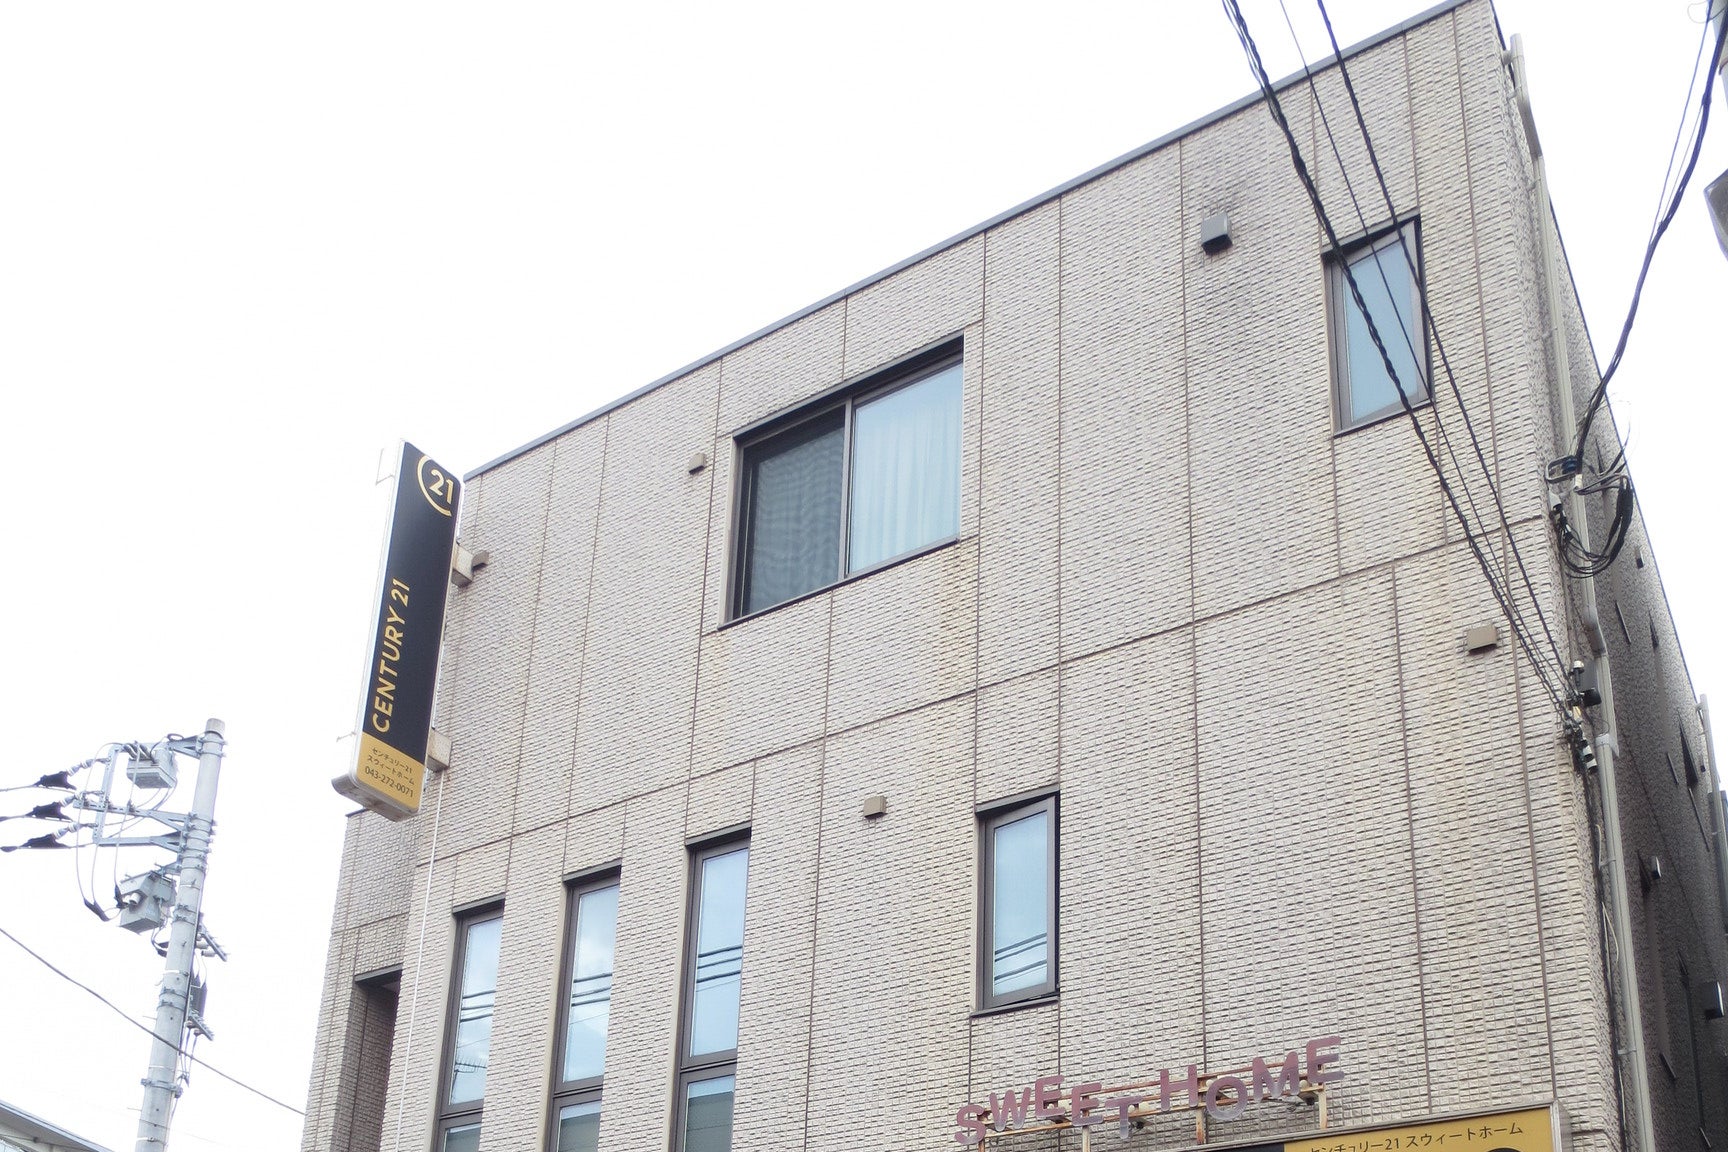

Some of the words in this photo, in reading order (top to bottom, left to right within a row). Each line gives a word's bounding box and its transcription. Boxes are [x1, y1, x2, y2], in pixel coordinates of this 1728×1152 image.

[372, 607, 408, 733] CENTURY
[392, 577, 410, 606] 21
[368, 755, 415, 786] スウィートホーム
[371, 746, 413, 774] センチュリー21
[365, 766, 415, 798] 043-272-0071
[954, 1074, 1142, 1146] SWEET
[1160, 1035, 1345, 1121] HOME
[1406, 1122, 1523, 1149] スウィートホーム
